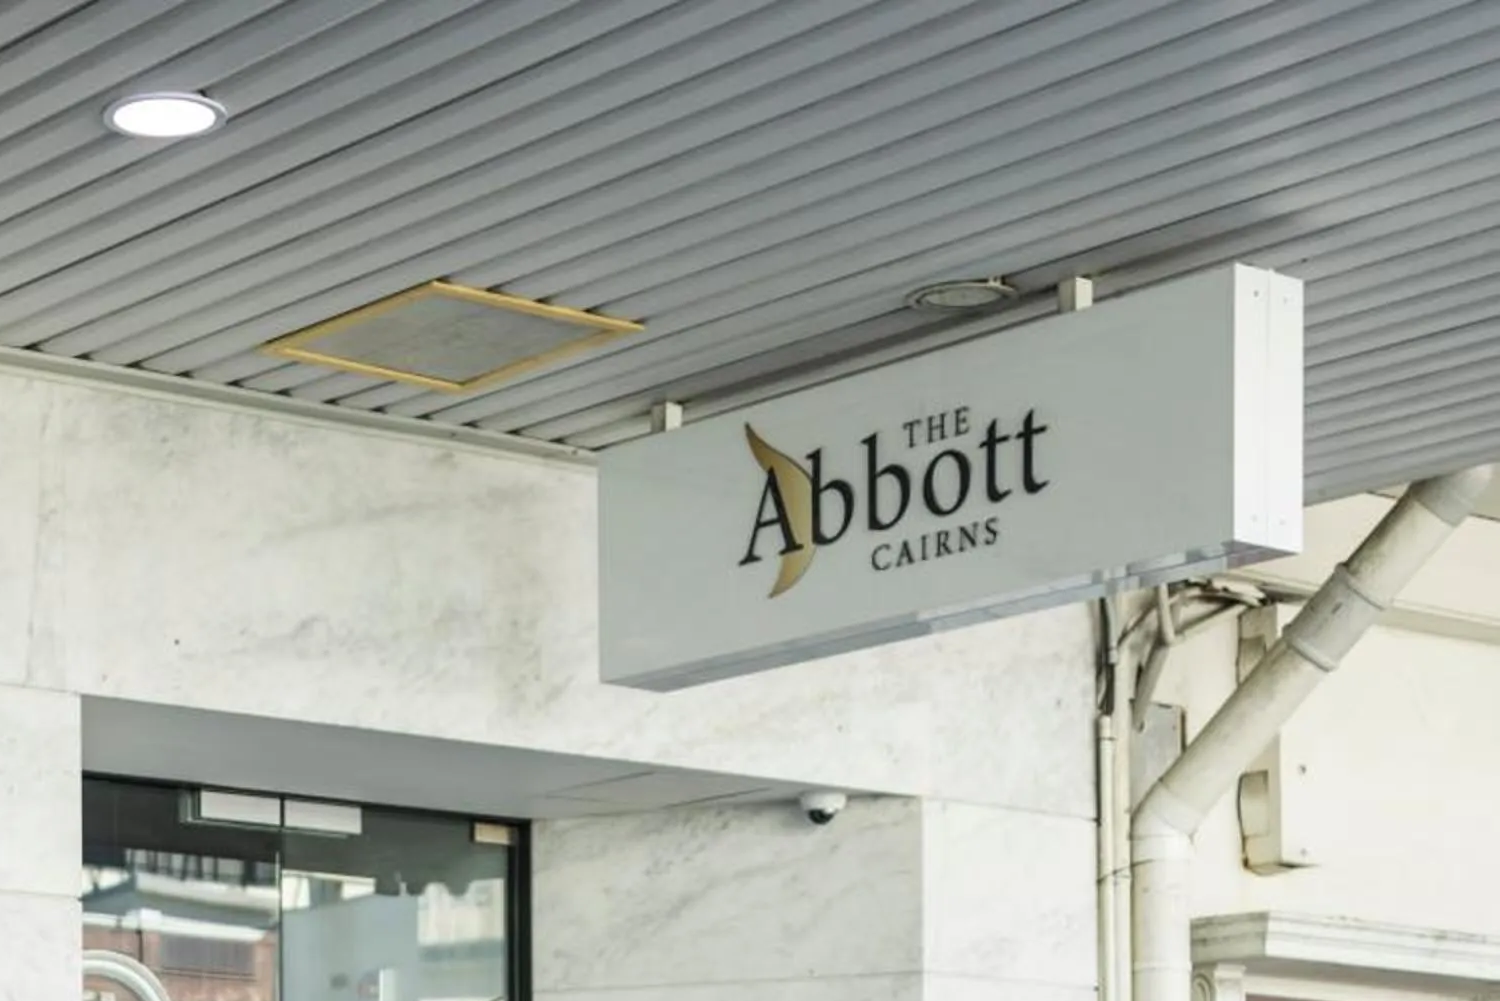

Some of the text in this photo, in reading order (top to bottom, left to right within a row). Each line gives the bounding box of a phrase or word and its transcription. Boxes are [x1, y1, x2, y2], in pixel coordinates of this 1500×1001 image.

[903, 406, 971, 448] THE
[738, 408, 1050, 565] Abbott
[871, 516, 1000, 572] CAIRNS
